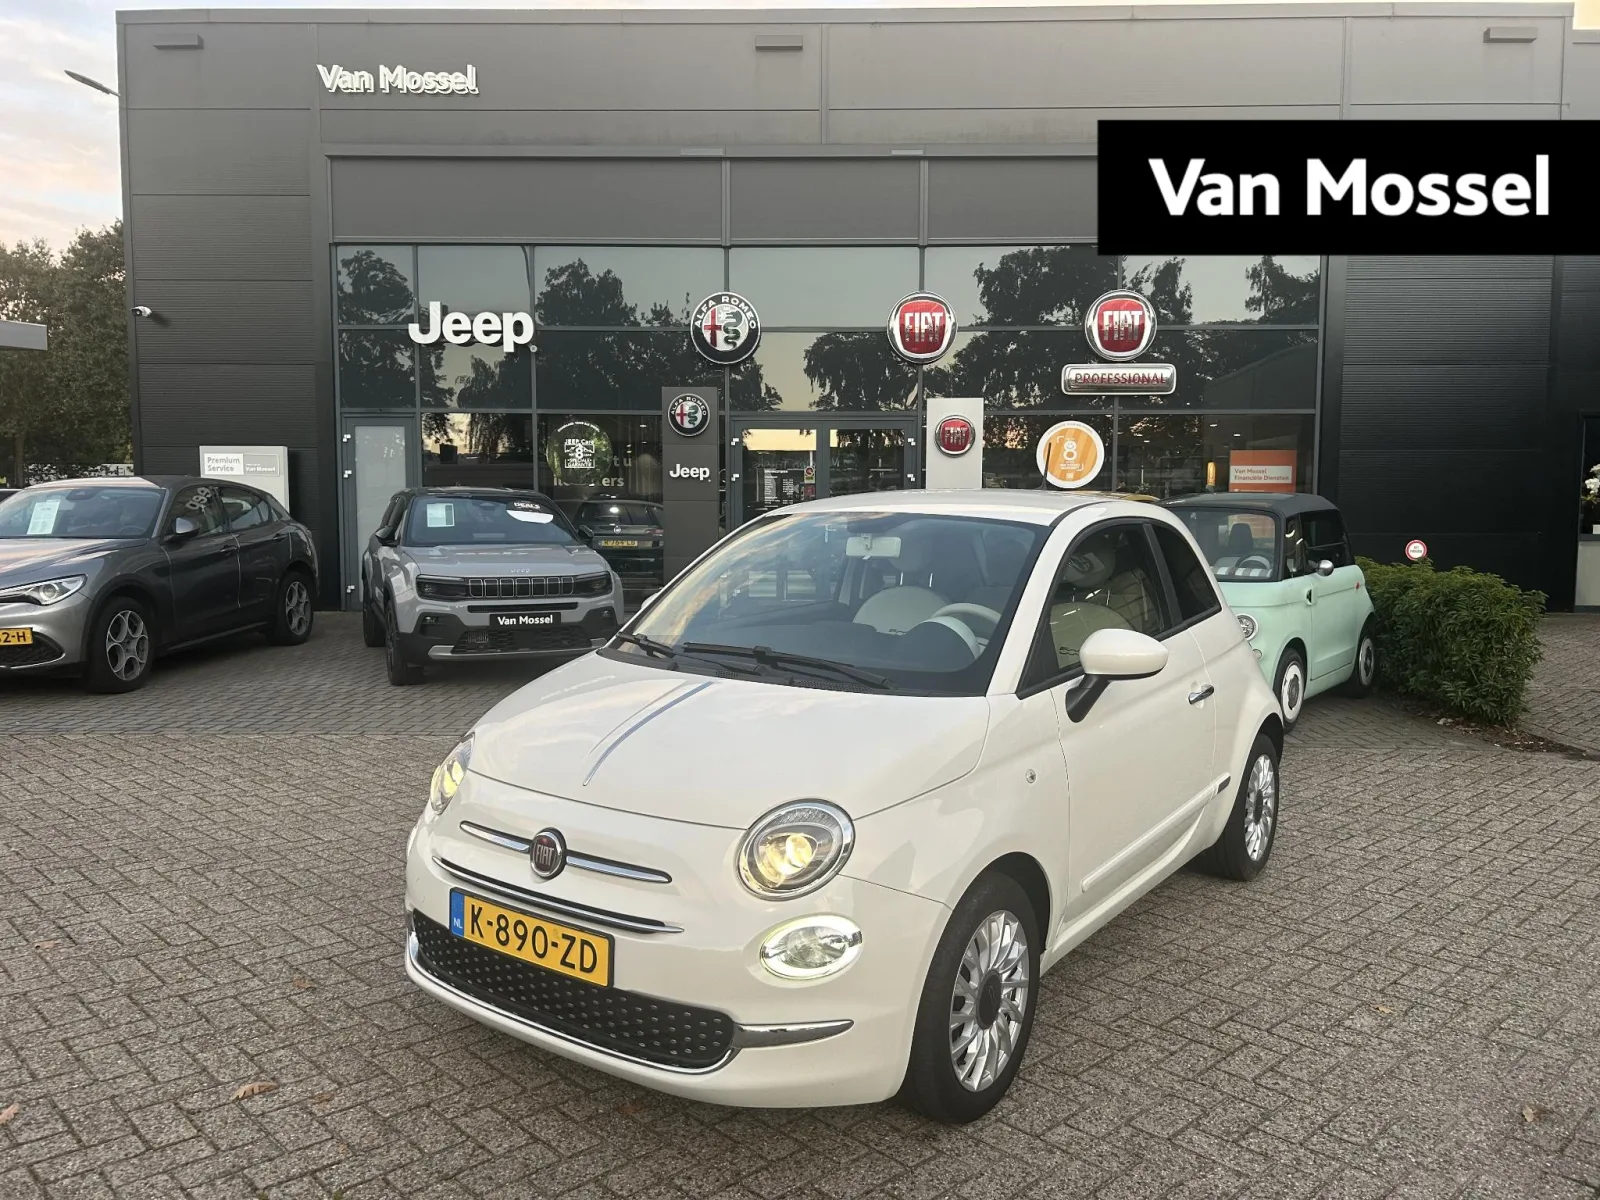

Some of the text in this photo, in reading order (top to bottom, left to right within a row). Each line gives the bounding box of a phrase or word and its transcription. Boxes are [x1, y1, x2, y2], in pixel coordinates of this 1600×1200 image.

[317, 64, 479, 94] Van Mossel
[694, 295, 757, 330] ALFA ROMEO
[408, 301, 534, 353] Jeep
[904, 311, 944, 343] FIAT
[1102, 309, 1143, 342] FIAT
[1074, 372, 1167, 385] PROFESSIONAL
[670, 396, 707, 416] ALFA ROMEO
[944, 426, 969, 446] FIAT
[207, 456, 240, 465] Premium
[575, 447, 584, 460] 8
[1063, 440, 1077, 461] 8
[207, 465, 235, 473] Service
[669, 463, 710, 482] Jeep
[497, 614, 553, 626] Van Mossel
[0, 631, 27, 643] 2-H
[535, 843, 555, 869] FIAT
[453, 917, 463, 929] NL
[470, 904, 598, 974] K-890-ZD
